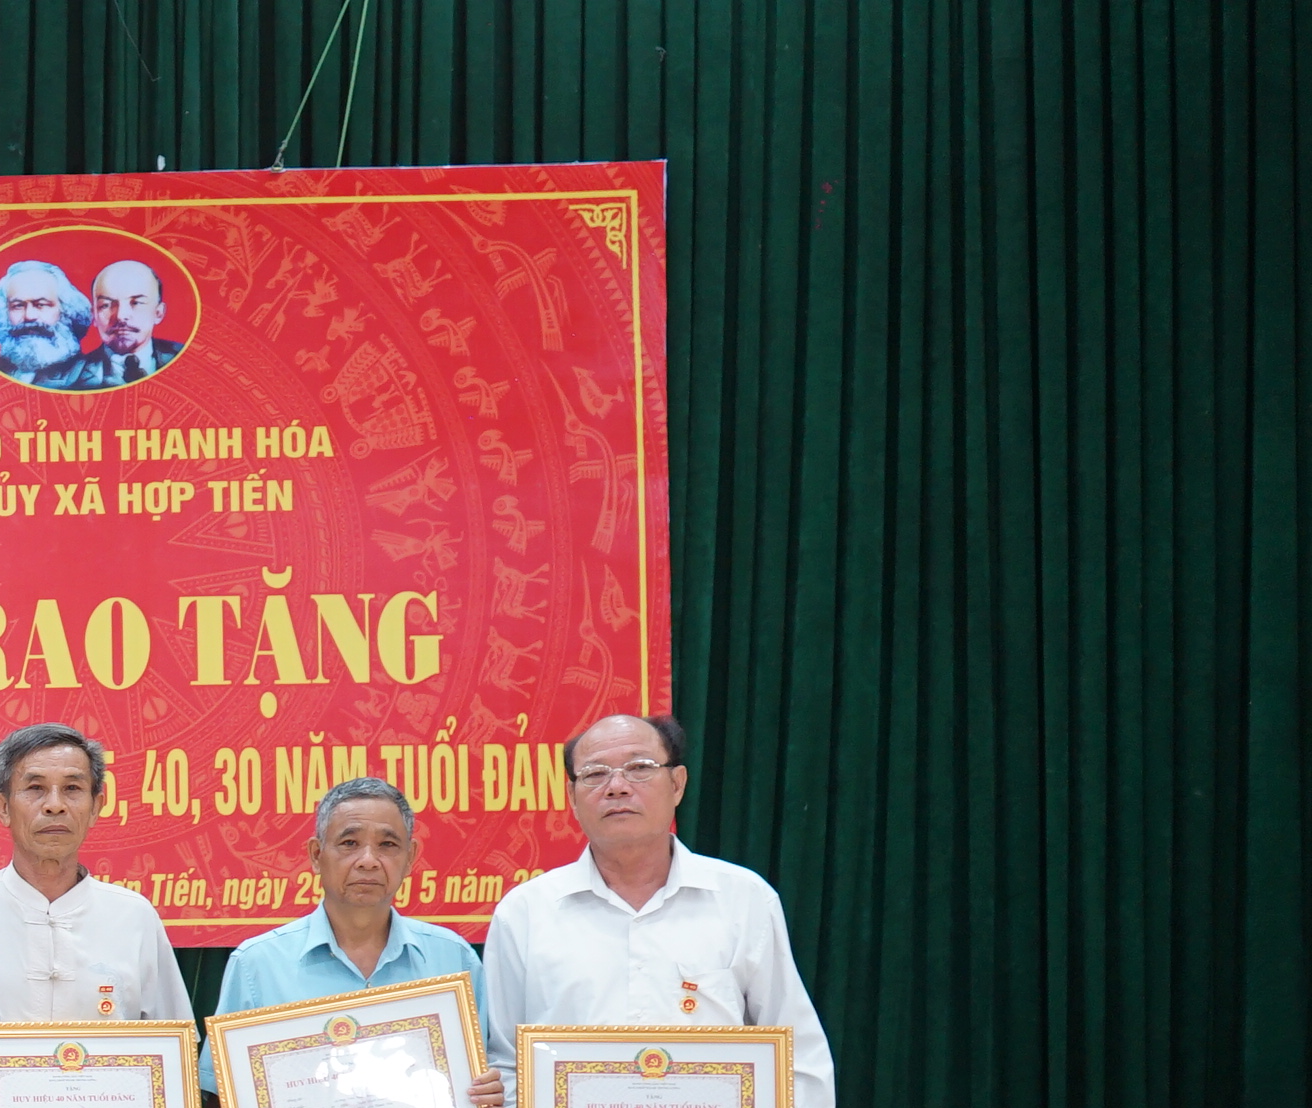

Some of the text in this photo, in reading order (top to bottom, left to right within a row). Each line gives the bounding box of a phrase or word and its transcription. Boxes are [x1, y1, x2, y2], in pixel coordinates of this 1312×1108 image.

[14, 420, 102, 462] TỈNH
[115, 427, 243, 461] THANH
[256, 417, 334, 458] HÓA
[54, 477, 106, 515] XÃ
[118, 481, 195, 521] HỢP
[207, 468, 293, 512] TIẾN
[178, 566, 444, 719] TẶNG
[141, 748, 201, 825] 40,
[214, 747, 262, 816] 30
[380, 715, 469, 813] TUỔI
[482, 712, 566, 811] ĐẢN
[150, 868, 213, 911] Tiến,
[222, 871, 288, 910] ngày
[419, 870, 438, 904] 5
[444, 868, 504, 904] năm
[33, 1095, 54, 1103] HIỆU
[66, 1094, 86, 1102] NĂM
[88, 1092, 109, 1101] TUỔI
[286, 1080, 306, 1088] HUY
